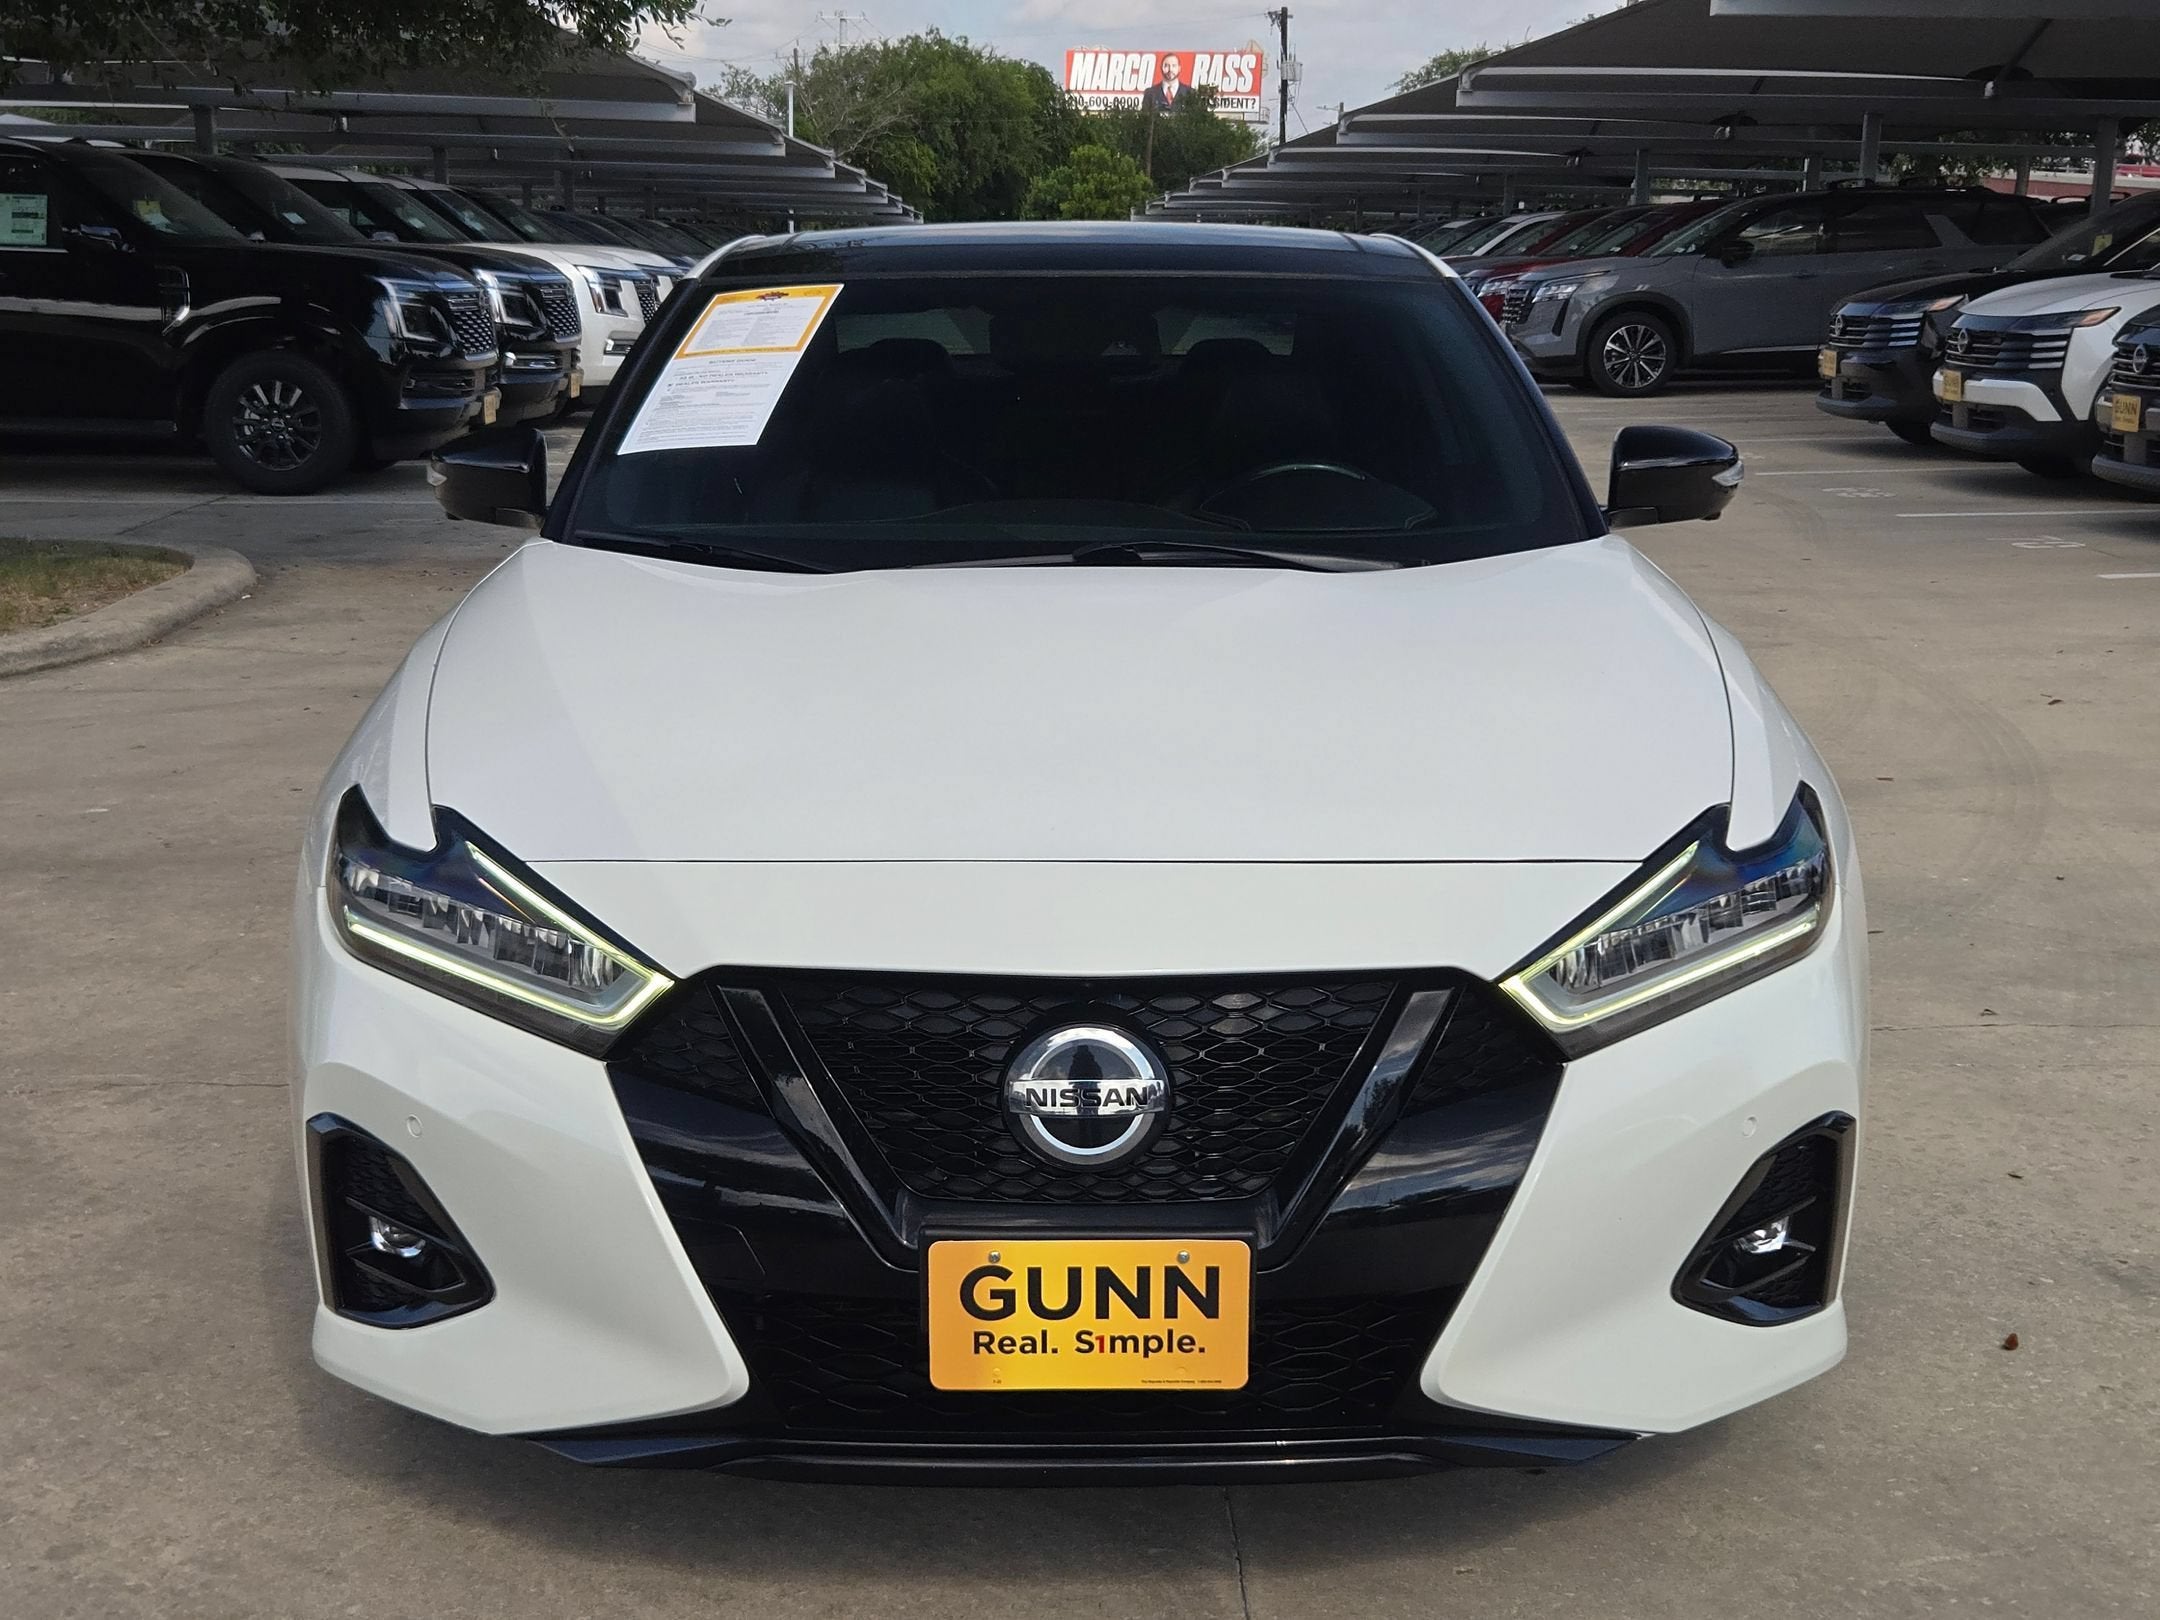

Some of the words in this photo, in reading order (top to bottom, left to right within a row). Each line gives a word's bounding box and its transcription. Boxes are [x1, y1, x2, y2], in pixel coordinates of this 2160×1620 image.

[1069, 52, 1156, 91] MARCO
[1025, 1087, 1148, 1108] NISSAN
[959, 1264, 1220, 1322] GUNN
[973, 1329, 1059, 1355] Real.
